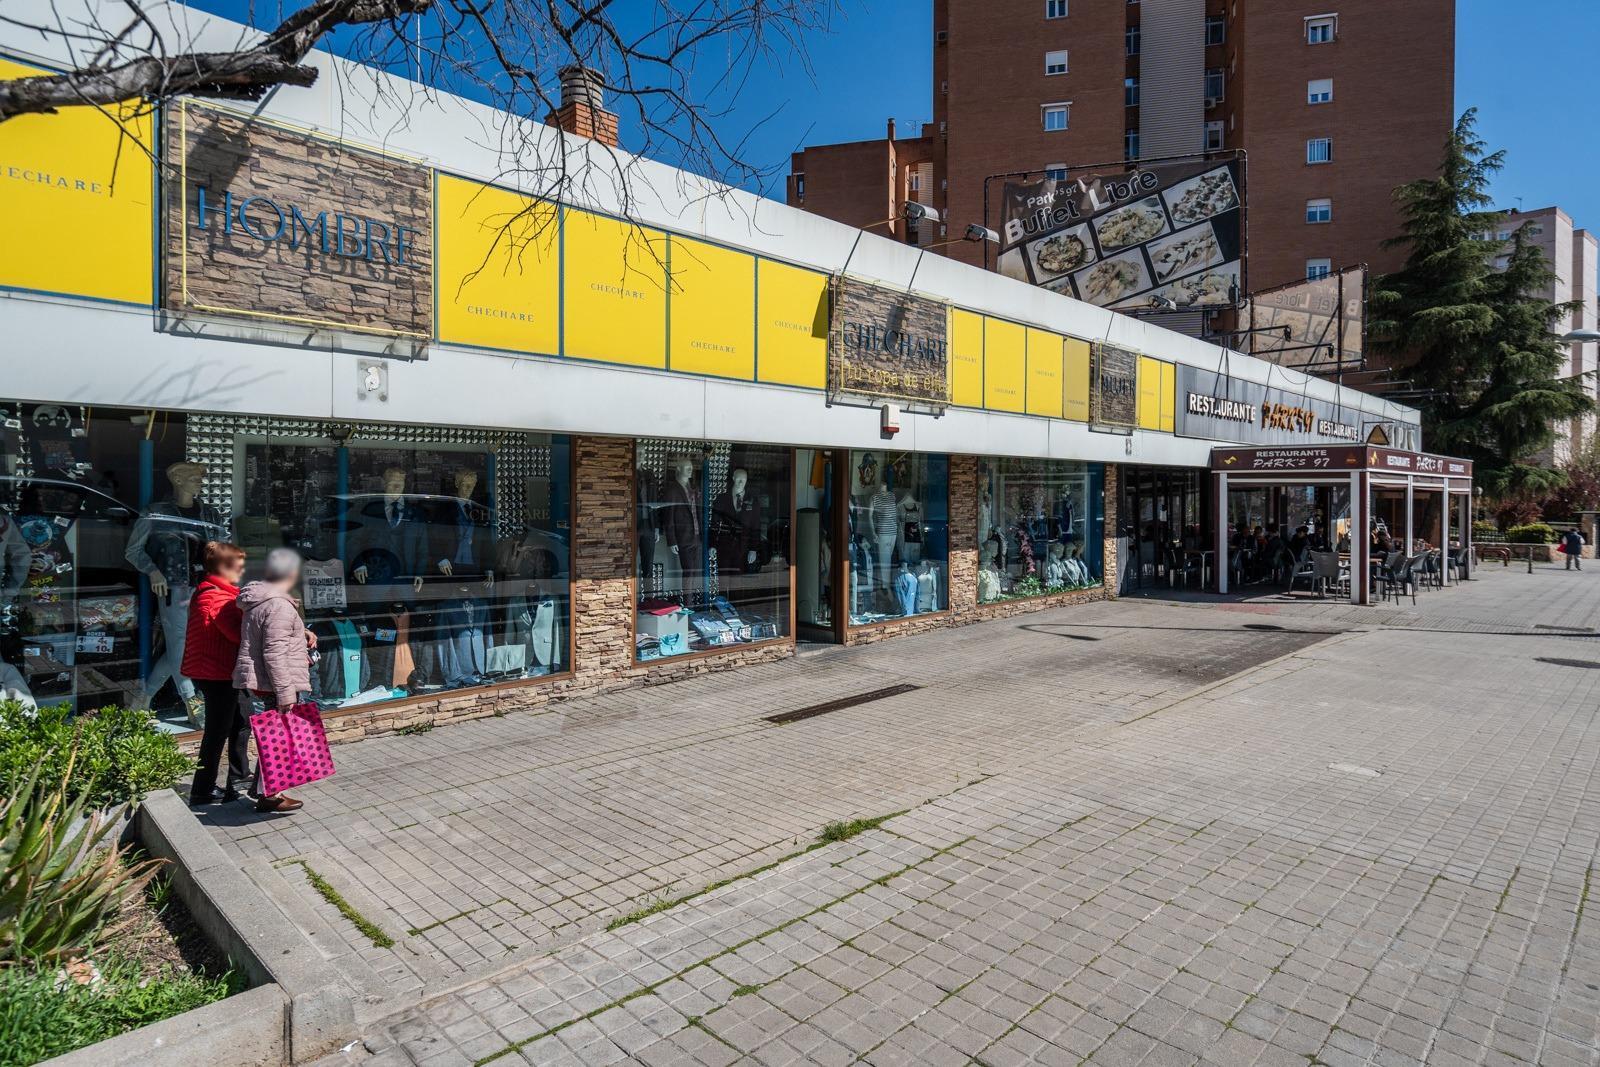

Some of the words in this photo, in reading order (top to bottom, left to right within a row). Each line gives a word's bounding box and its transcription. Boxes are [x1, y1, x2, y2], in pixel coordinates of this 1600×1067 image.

[1005, 199, 1080, 245] Buffet
[1089, 171, 1158, 211] Libre
[197, 185, 422, 268] HOMBRE
[467, 305, 534, 323] CHECHARE
[690, 340, 736, 354] CHECHARE
[843, 322, 946, 361] CHECHARE
[867, 368, 899, 388] ropa
[1190, 393, 1257, 421] RESTAURANTE
[1319, 420, 1358, 440] RESTAURANTE
[1256, 449, 1327, 457] RESTAURANTE
[1313, 457, 1330, 467] 97
